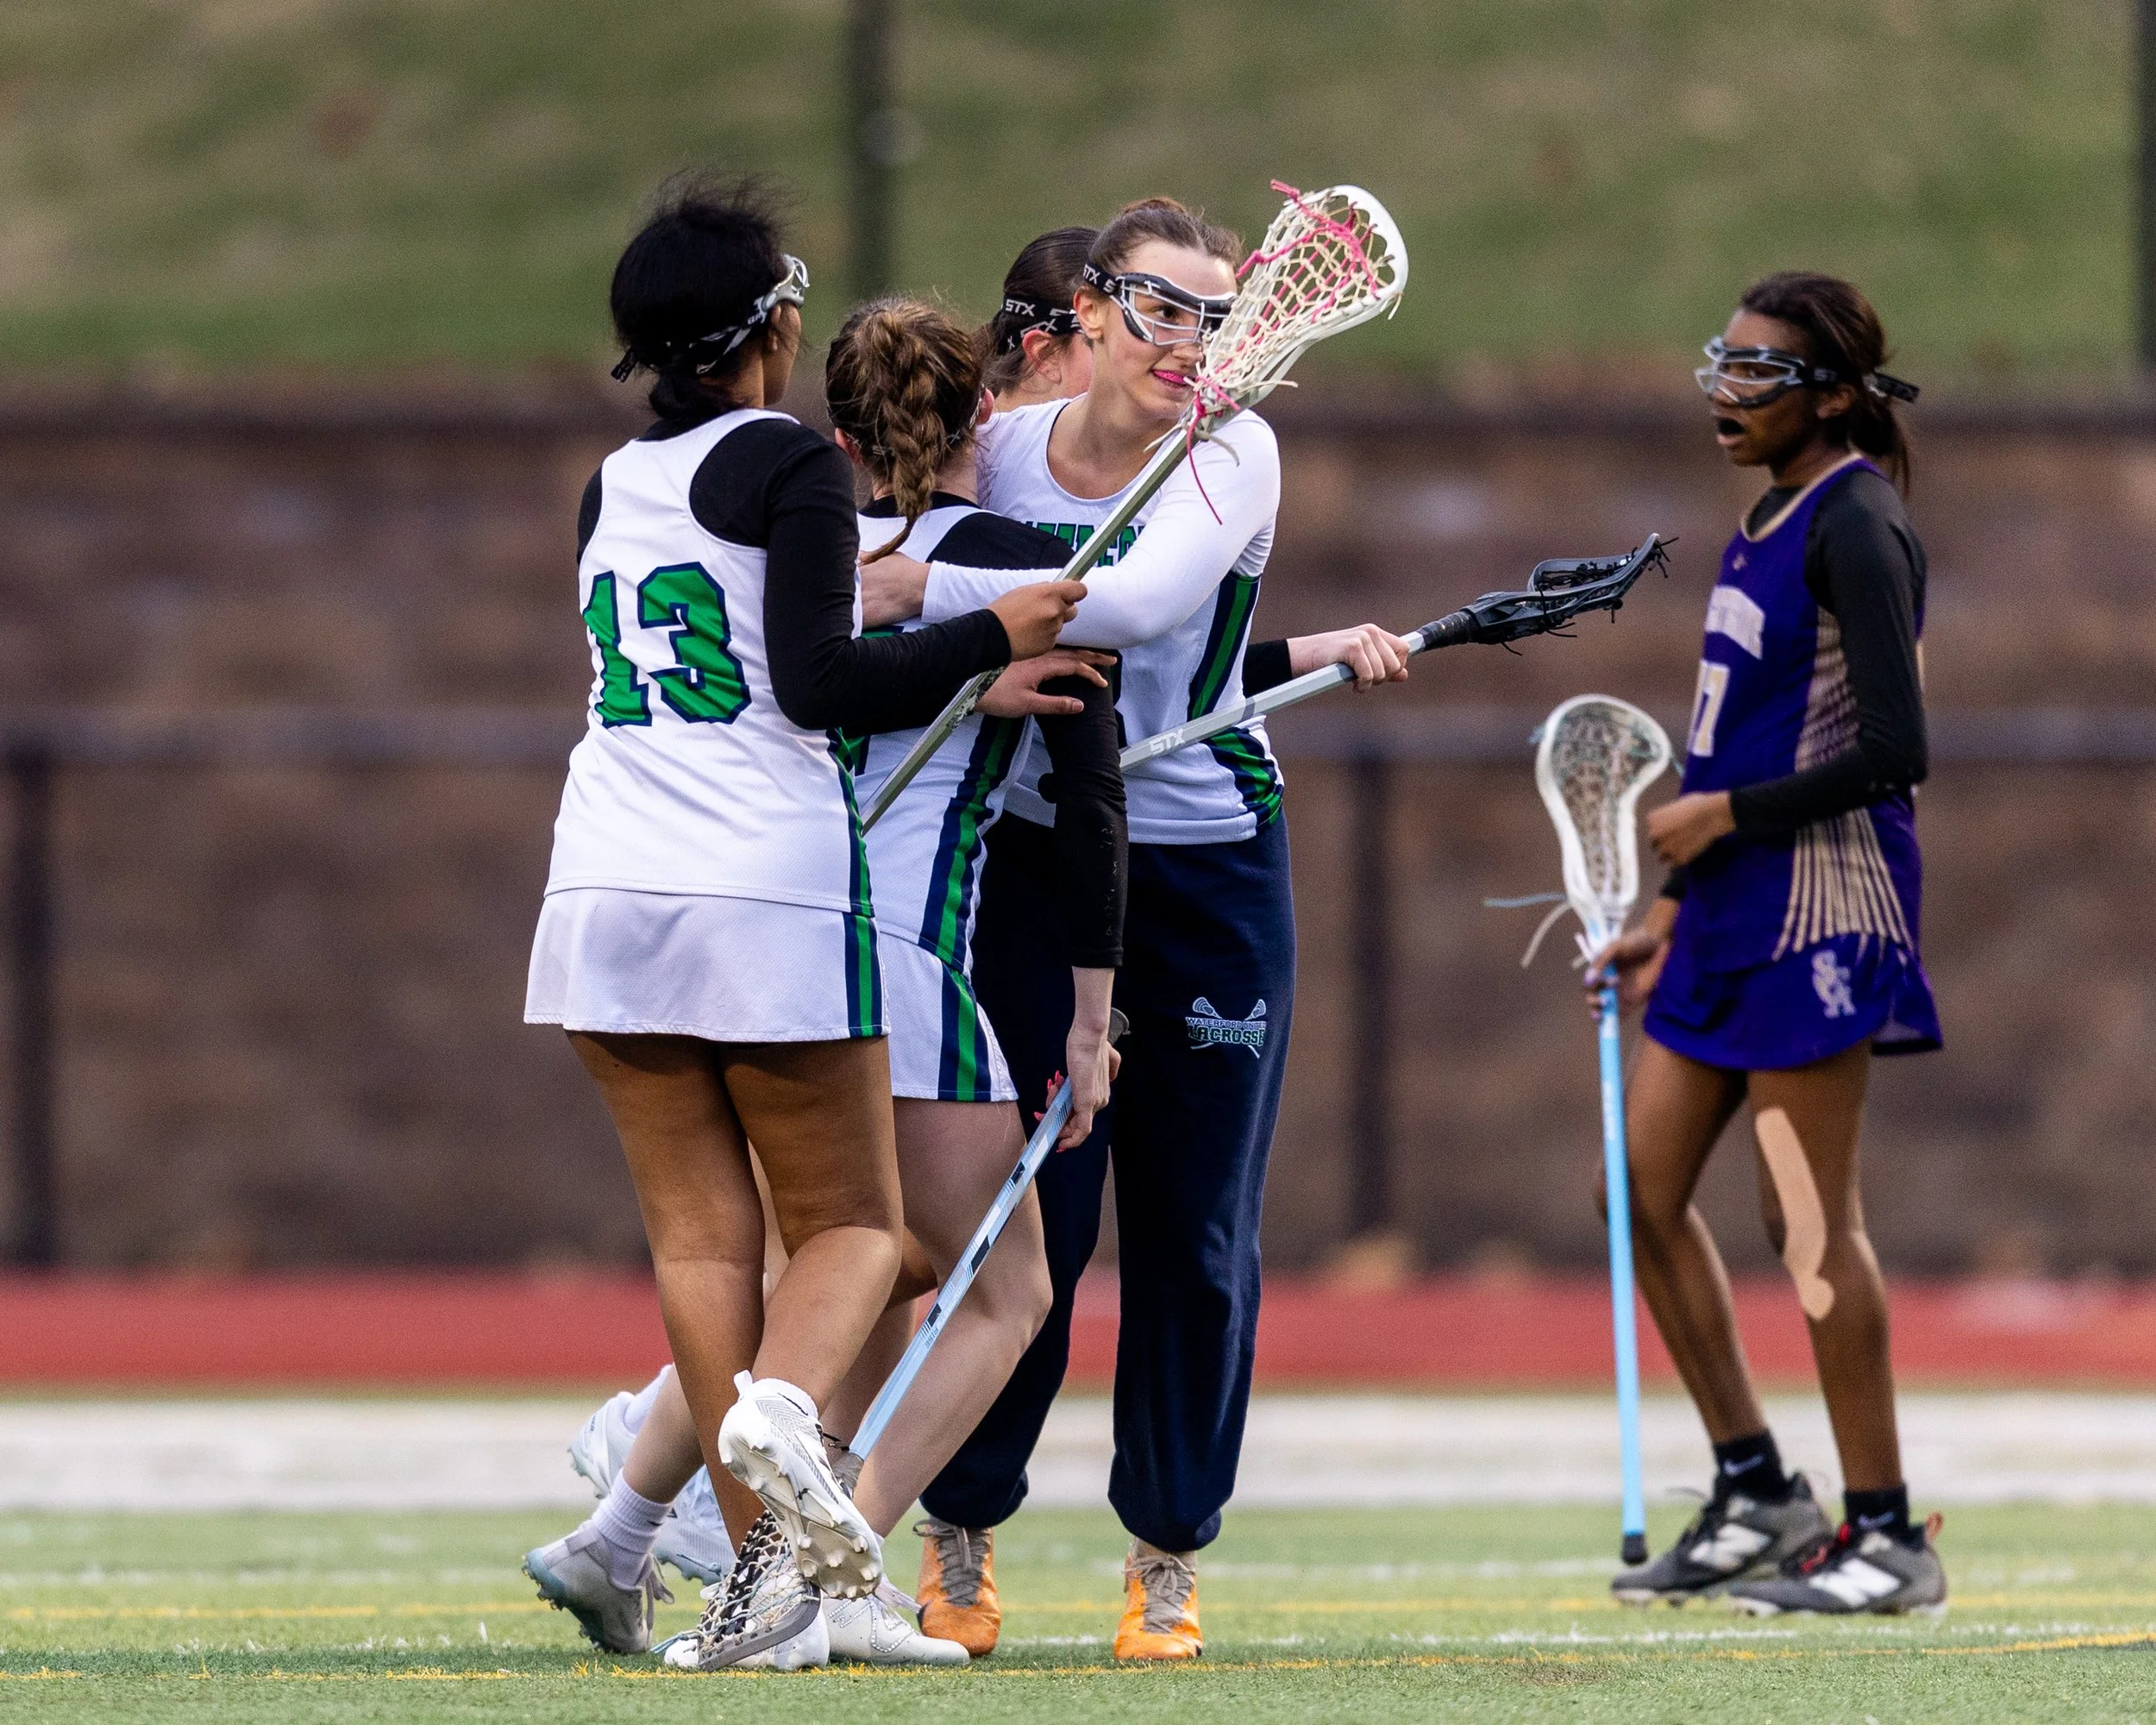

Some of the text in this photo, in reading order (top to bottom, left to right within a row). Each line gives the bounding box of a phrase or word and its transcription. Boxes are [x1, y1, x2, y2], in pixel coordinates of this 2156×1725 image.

[1006, 299, 1035, 317] STX
[582, 561, 752, 729] 13
[1149, 728, 1185, 755] STX
[1187, 1018, 1242, 1029] WATERFORD
[1188, 1024, 1265, 1046] LACROSSE
